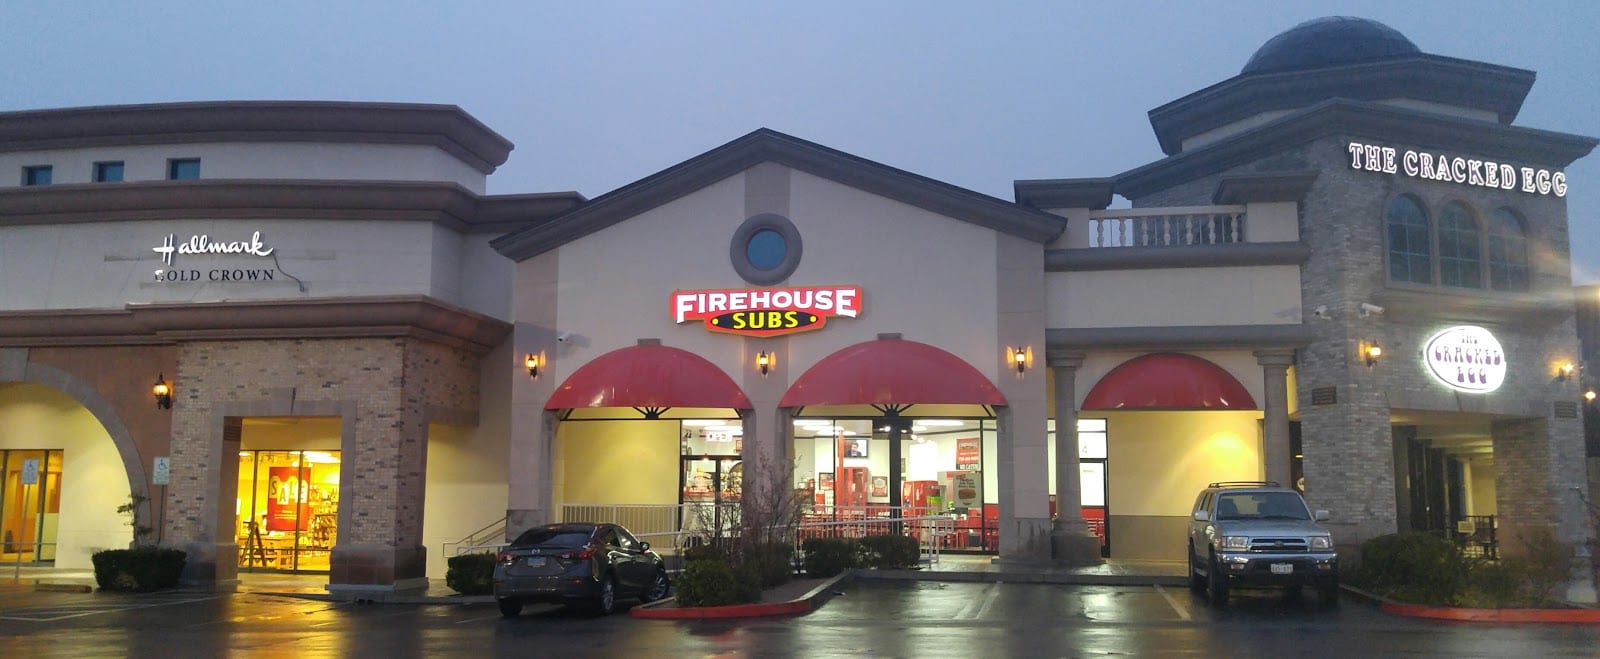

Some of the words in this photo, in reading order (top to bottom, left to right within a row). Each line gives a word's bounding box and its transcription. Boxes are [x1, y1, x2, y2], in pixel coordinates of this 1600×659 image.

[1349, 143, 1397, 174] THE
[1403, 151, 1516, 189] CRACKED
[1521, 167, 1567, 197] EGG
[152, 231, 273, 266] Hallmark
[154, 269, 200, 282] GOLD
[209, 269, 274, 281] CROWN
[676, 288, 857, 324] FIREHOUSE
[733, 311, 799, 329] SUBS
[1435, 345, 1500, 365] CRACKED
[1457, 366, 1486, 384] EGG
[270, 479, 307, 502] SALE
